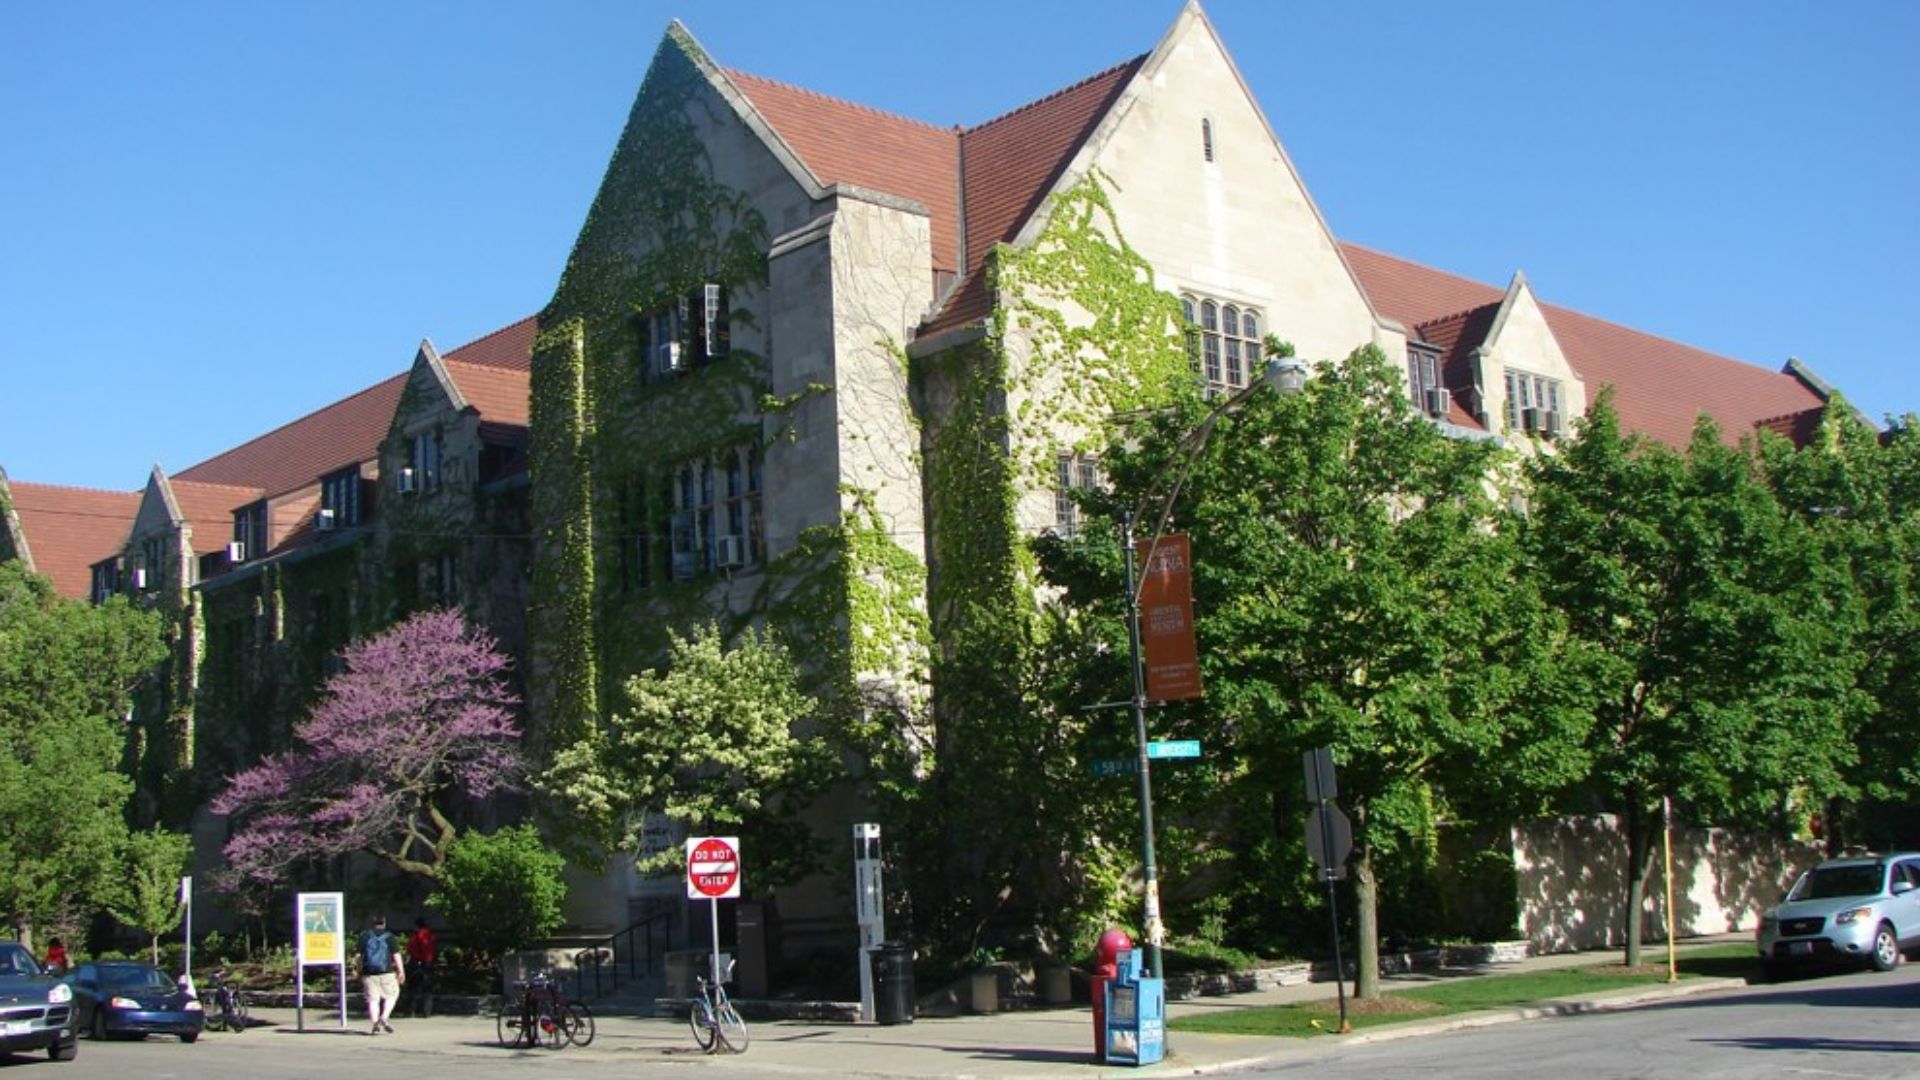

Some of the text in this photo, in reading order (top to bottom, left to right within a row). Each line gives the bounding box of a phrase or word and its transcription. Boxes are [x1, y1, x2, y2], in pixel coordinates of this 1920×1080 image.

[695, 849, 731, 860] DO NOT
[699, 876, 729, 886] ENTER
